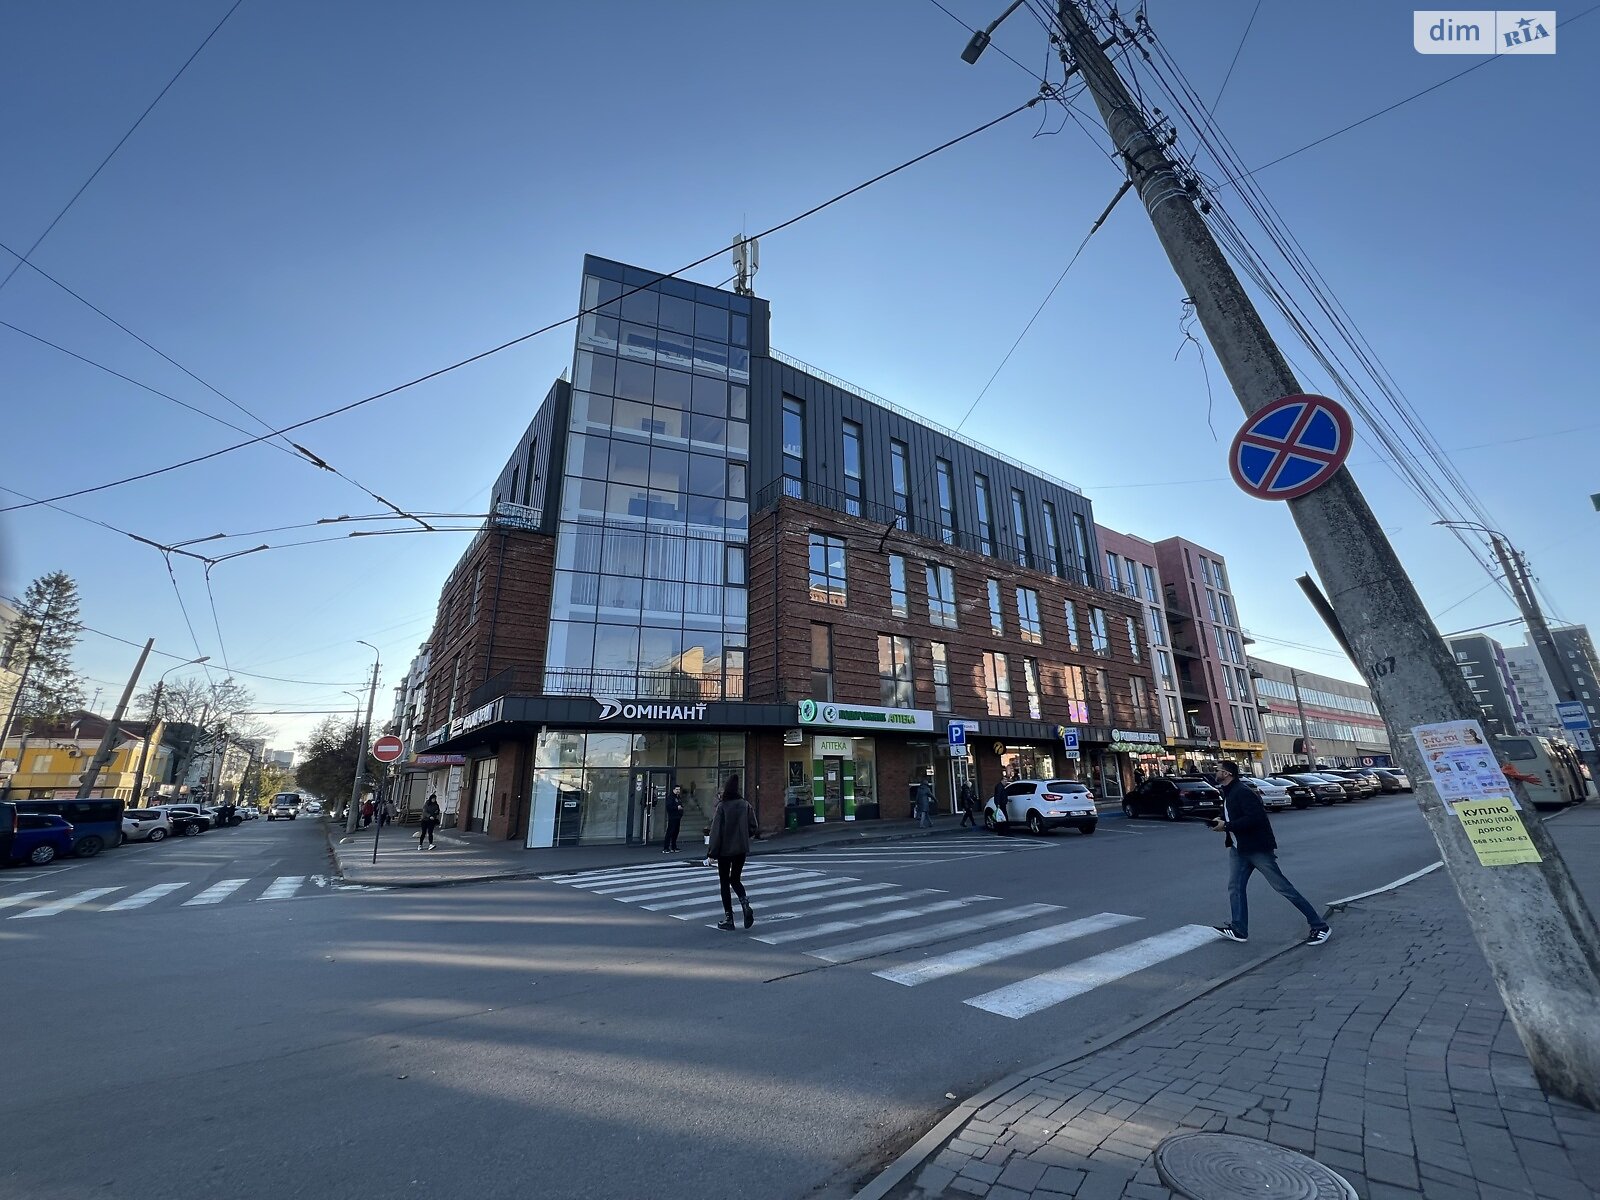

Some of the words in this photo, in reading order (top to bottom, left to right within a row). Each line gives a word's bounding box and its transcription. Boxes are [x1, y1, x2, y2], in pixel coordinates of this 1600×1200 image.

[887, 712, 916, 724] АПТЕКА
[952, 726, 961, 742] P
[821, 741, 847, 750] АПТЕКА
[1067, 735, 1074, 746] P
[1462, 805, 1509, 817] КУПЛЮ
[1463, 817, 1493, 826] ЗЕМЛЮ
[1495, 815, 1520, 825] (ПАЙ)
[1478, 825, 1513, 835] ДОРОГО
